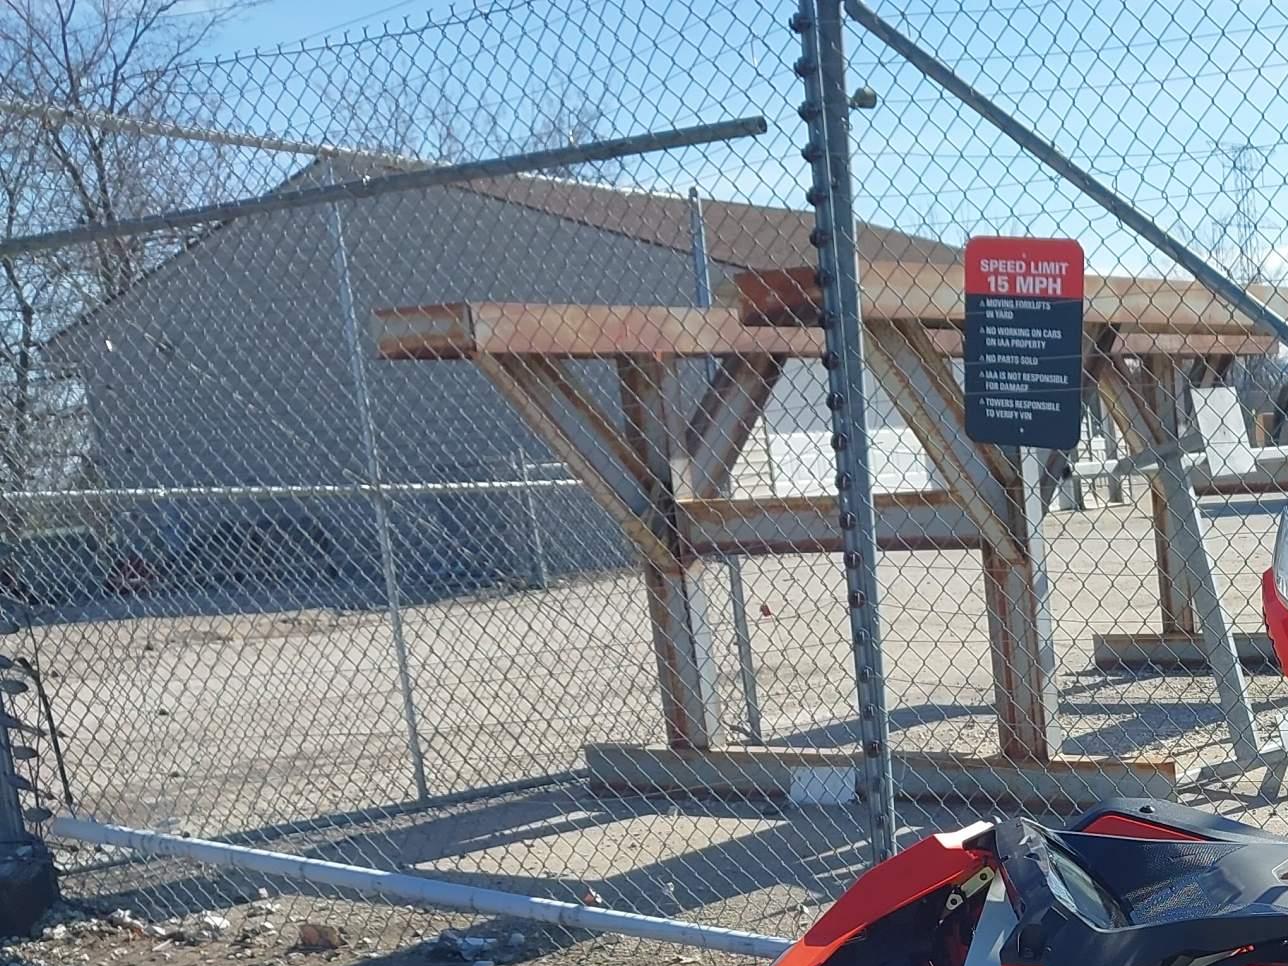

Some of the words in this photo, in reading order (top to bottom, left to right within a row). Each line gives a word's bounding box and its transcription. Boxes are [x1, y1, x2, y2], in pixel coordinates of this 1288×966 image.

[980, 259, 1026, 273] SPEED
[1030, 261, 1069, 275] LIMIT
[987, 276, 1009, 293] 15
[1015, 276, 1062, 295] MPH
[986, 298, 1014, 309] MOVING
[1015, 300, 1051, 311] FORKLIFTS
[986, 310, 995, 319] IN
[995, 311, 1014, 320] YARD
[986, 326, 997, 336] NO
[997, 327, 1030, 338] WORKING
[1031, 329, 1042, 338] ON
[1043, 329, 1063, 340] CARS
[985, 337, 997, 347] ON
[997, 338, 1010, 348] IAA
[1011, 339, 1046, 350] PROPERTY
[985, 353, 996, 363] NO
[997, 354, 1020, 365] PARTS
[1020, 356, 1039, 366] SOLD
[985, 370, 998, 380] IAA
[999, 371, 1006, 380] IS
[1007, 371, 1021, 381] NOT
[1022, 372, 1069, 385] RESPONSIBLE
[985, 381, 999, 391] FOR
[999, 382, 1029, 393] DAMAGE
[985, 398, 1014, 409] TOWERS
[1014, 399, 1060, 412] RESPONSIBLE
[985, 409, 995, 418] TO
[996, 409, 1020, 420] VERIFY
[1020, 411, 1033, 421] VIN
